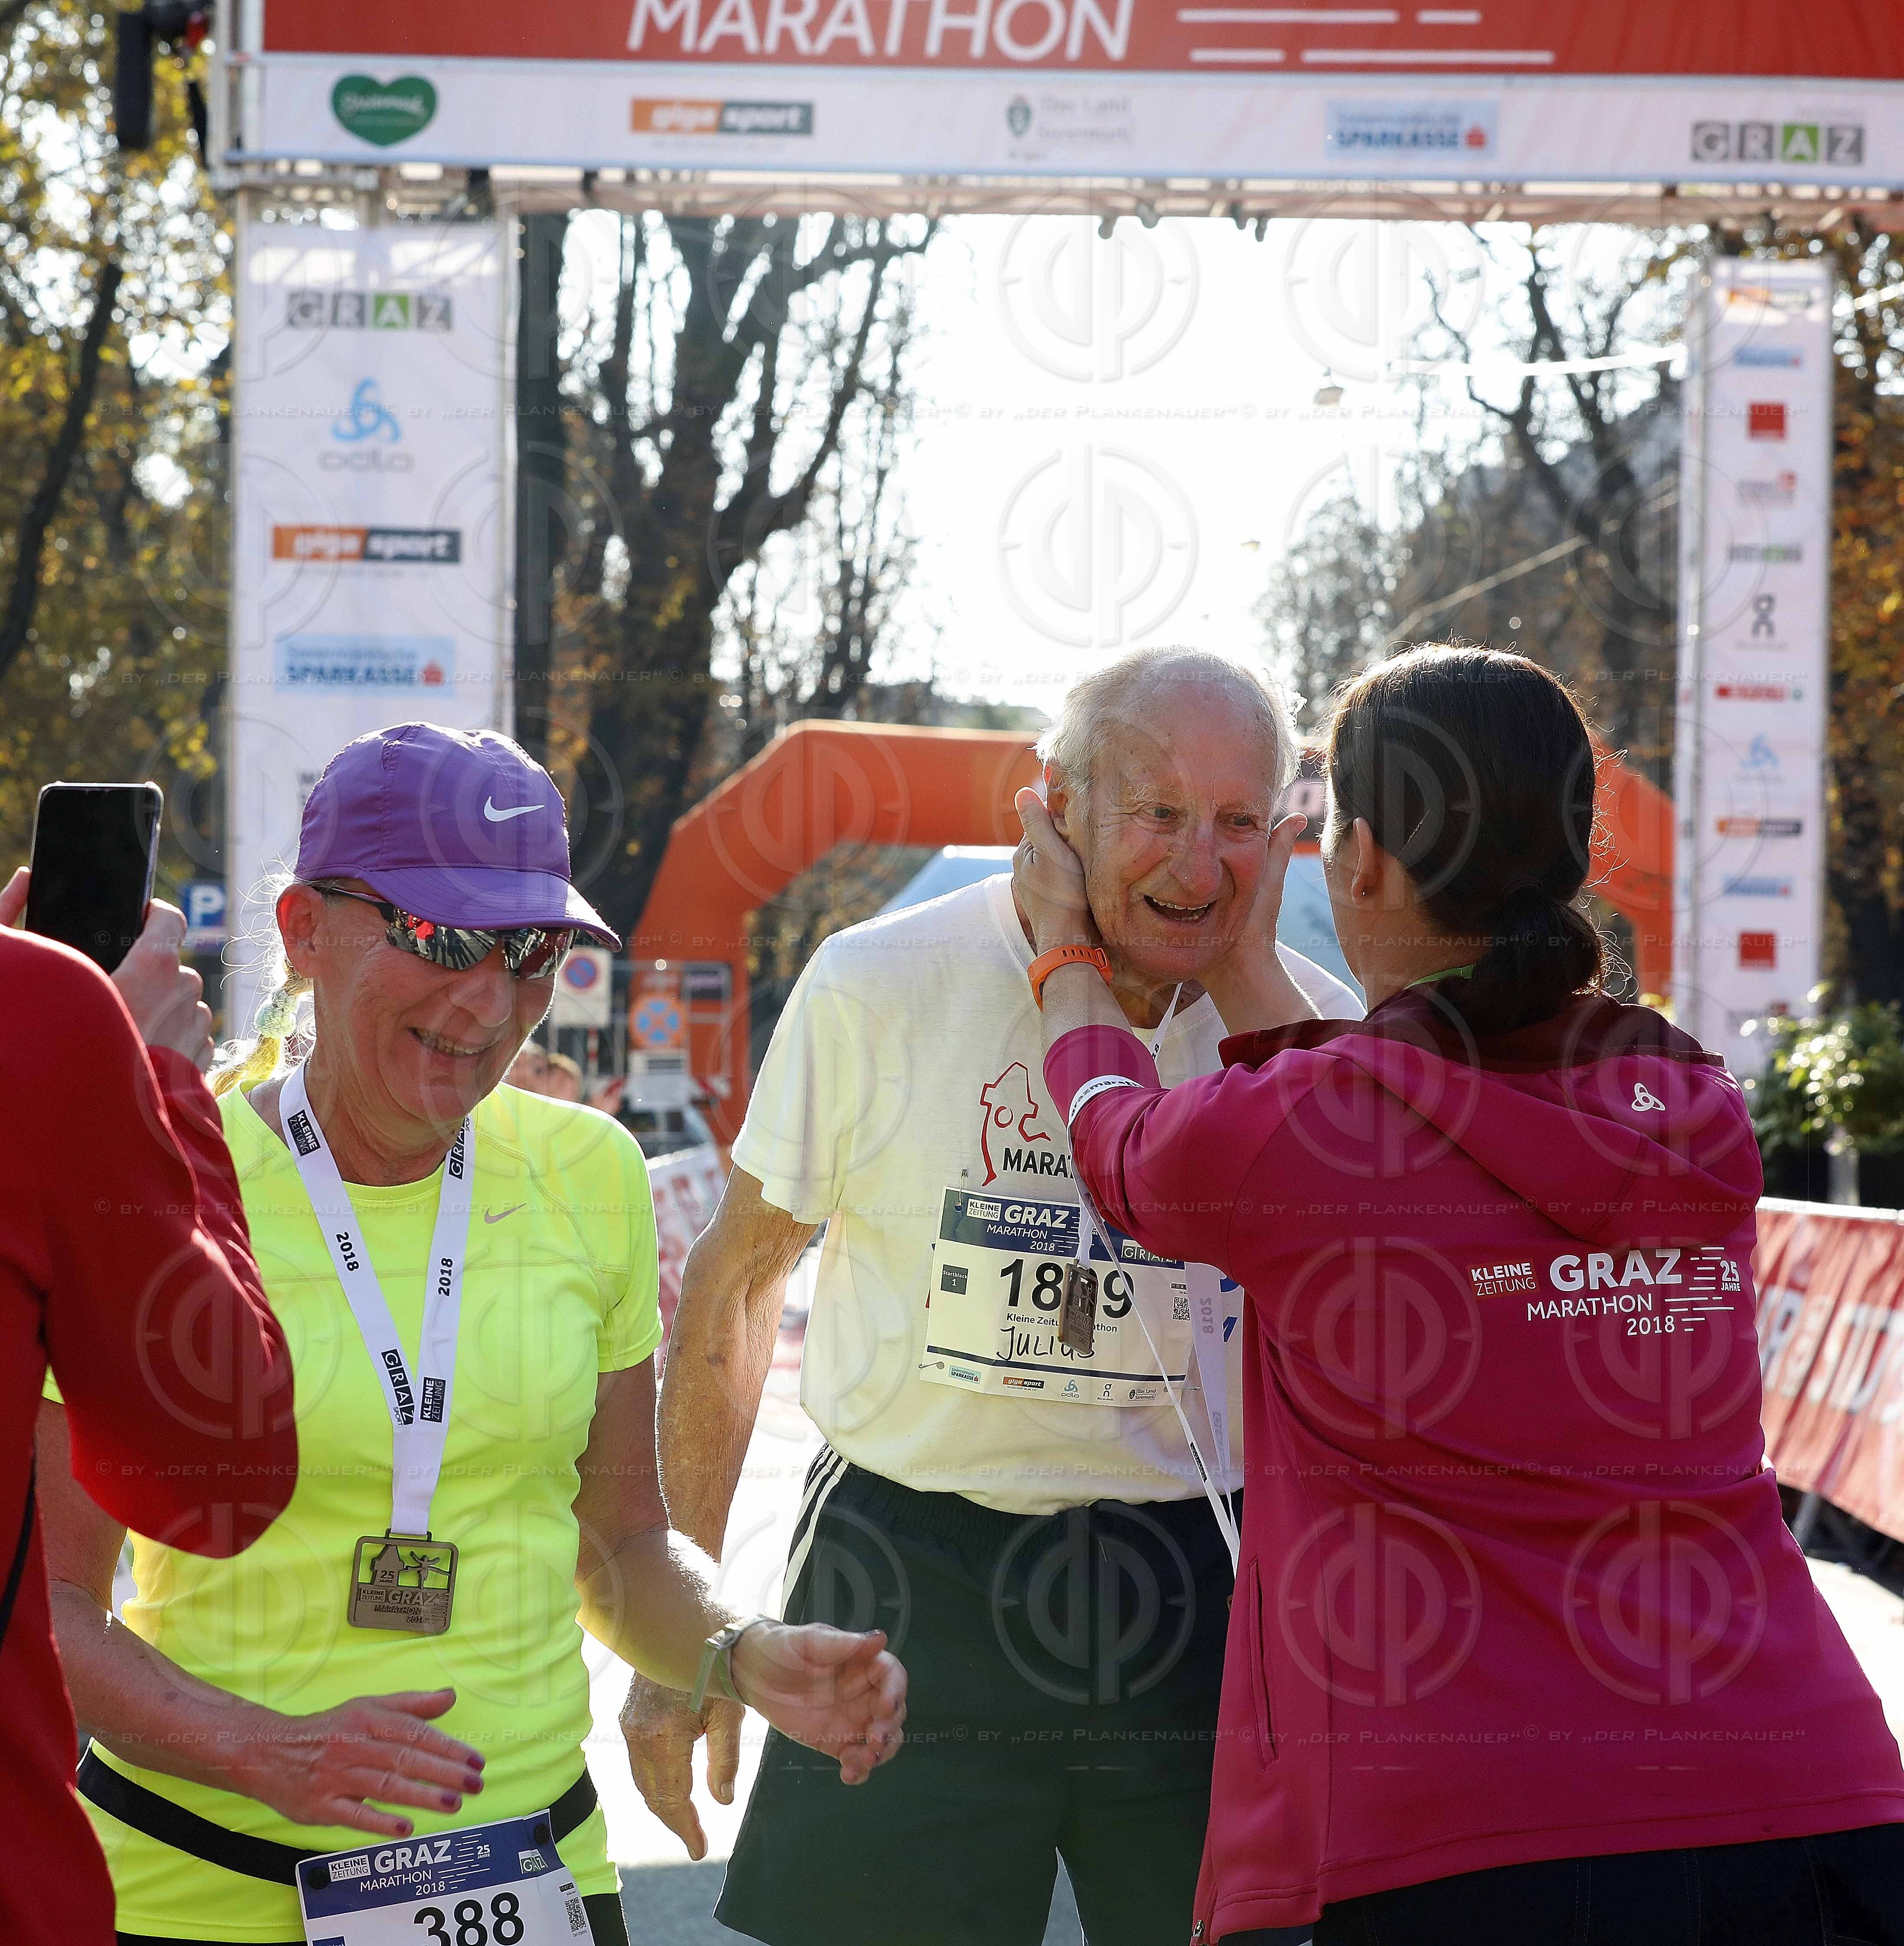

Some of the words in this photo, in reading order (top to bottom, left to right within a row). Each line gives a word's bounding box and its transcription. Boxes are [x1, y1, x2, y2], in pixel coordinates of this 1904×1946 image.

[626, 0, 1134, 61] MARATHON
[1692, 122, 1864, 165] GRAZ
[287, 291, 453, 331] GRAZ
[190, 886, 223, 927] P
[289, 1118, 309, 1154] ZEITUNG
[297, 1112, 317, 1150] KLEINE
[968, 1208, 999, 1219] ZEITUNG
[969, 1201, 1000, 1211] KLEINE
[1004, 1205, 1070, 1229] GRAZ
[986, 1224, 1048, 1239] MARATHON
[335, 1231, 360, 1272] 2018
[1030, 1241, 1055, 1251] 2018
[438, 1257, 453, 1297] 2018
[943, 1270, 968, 1279] Startblock
[1471, 1263, 1533, 1281] KLEINE
[1550, 1248, 1682, 1292] GRAZ
[1720, 1260, 1740, 1282] 25
[951, 1278, 957, 1287] 1
[1000, 1258, 1134, 1319] 189
[1474, 1277, 1536, 1297] ZEITUNG
[1721, 1281, 1741, 1292] JAHRE
[1527, 1293, 1652, 1321] MARATHON
[1007, 1313, 1035, 1324] Kleine
[1627, 1316, 1675, 1336] 2018
[951, 1371, 974, 1381] SPARKASSE
[385, 1352, 414, 1422] GRAZ
[423, 1379, 435, 1419] KLEINE
[431, 1380, 443, 1420] ZEITUNG
[393, 1406, 403, 1426] SPORT
[380, 1570, 395, 1579] 25
[387, 1590, 437, 1606] GRAZ
[374, 1605, 421, 1615] MARATHON
[374, 1839, 452, 1874] GRAZ
[477, 1844, 490, 1855] 25
[331, 1857, 367, 1871] KLEINE
[332, 1866, 369, 1880] ZEITUNG
[360, 1869, 432, 1892] MARATHON
[415, 1881, 446, 1896] 2018
[413, 1892, 524, 1946] 388
